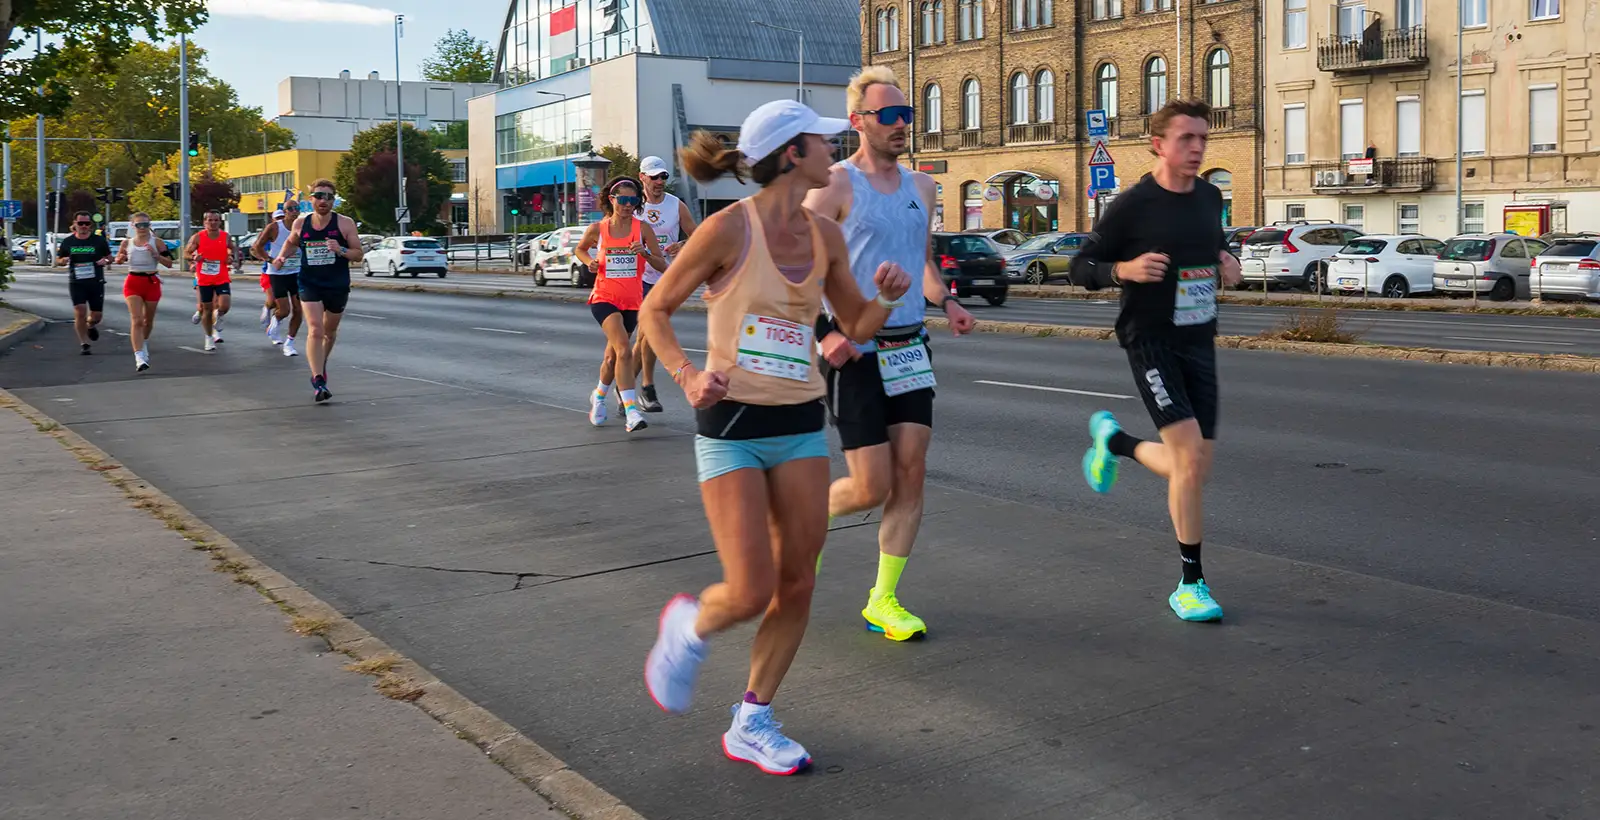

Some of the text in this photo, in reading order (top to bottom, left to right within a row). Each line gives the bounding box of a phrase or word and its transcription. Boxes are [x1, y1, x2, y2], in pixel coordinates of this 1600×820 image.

[1096, 168, 1109, 187] P
[766, 327, 804, 346] 11063
[888, 349, 923, 367] 12099
